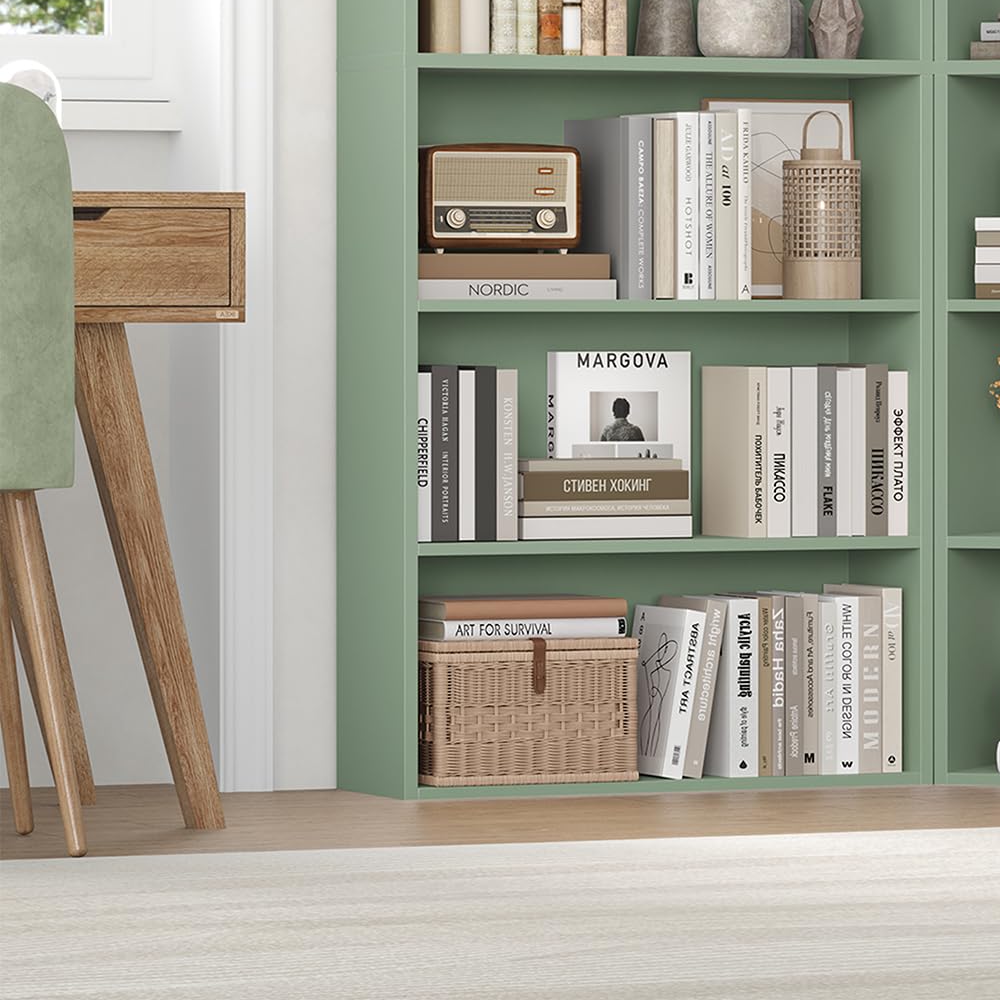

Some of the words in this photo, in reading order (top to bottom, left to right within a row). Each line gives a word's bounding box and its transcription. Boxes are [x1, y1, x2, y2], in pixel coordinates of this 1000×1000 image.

[705, 152, 713, 170] THE
[705, 171, 713, 207] ALLURE
[721, 185, 732, 207] 100
[684, 197, 693, 255] HOTSHOT
[705, 209, 713, 223] OF
[705, 223, 713, 258] WOMEN
[468, 284, 529, 297] NORDIC
[577, 352, 669, 368] MARGOVA
[893, 409, 903, 458] ЭФФЕКТ
[417, 417, 428, 488] CHIPPERFIELD
[563, 479, 607, 493] СТИВЕН
[610, 478, 652, 492] ХОКИНГ
[773, 453, 786, 503] ПИКАССО
[871, 449, 884, 516] ПИКАССО
[893, 461, 903, 502] ПЛАТО
[823, 486, 833, 516] FLAKE
[455, 625, 475, 636] ART
[479, 624, 501, 636] FOR
[504, 623, 552, 635] SURVIVAL
[863, 624, 879, 750] MODERN
